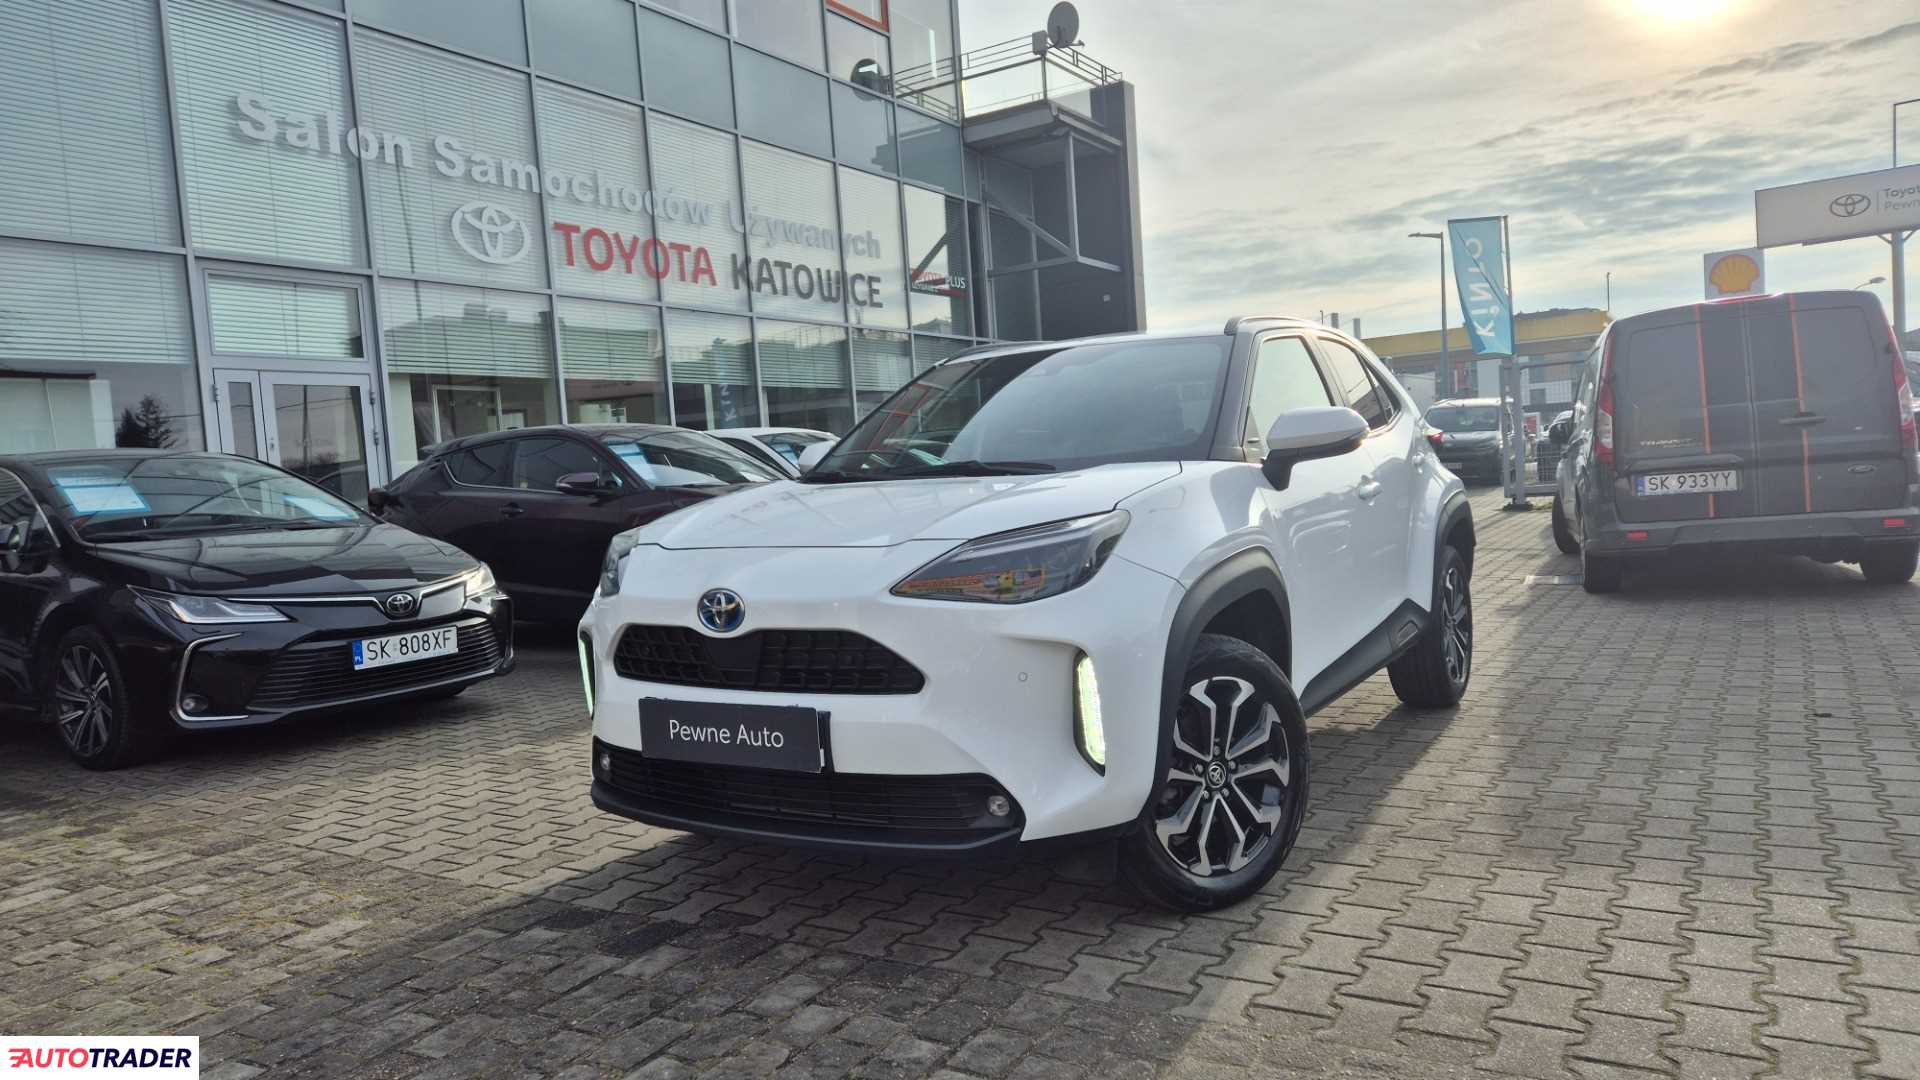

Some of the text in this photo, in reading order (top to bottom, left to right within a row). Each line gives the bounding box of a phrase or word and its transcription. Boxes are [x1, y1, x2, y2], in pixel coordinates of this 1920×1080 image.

[235, 92, 414, 169] Salon
[434, 134, 712, 225] Samochodów
[553, 221, 883, 309] TOYOTA KATOWICE
[1648, 477, 1670, 491] SK
[1677, 472, 1732, 489] 933YY
[367, 630, 453, 661] SK 808XF
[669, 719, 784, 748] Pewne Auto
